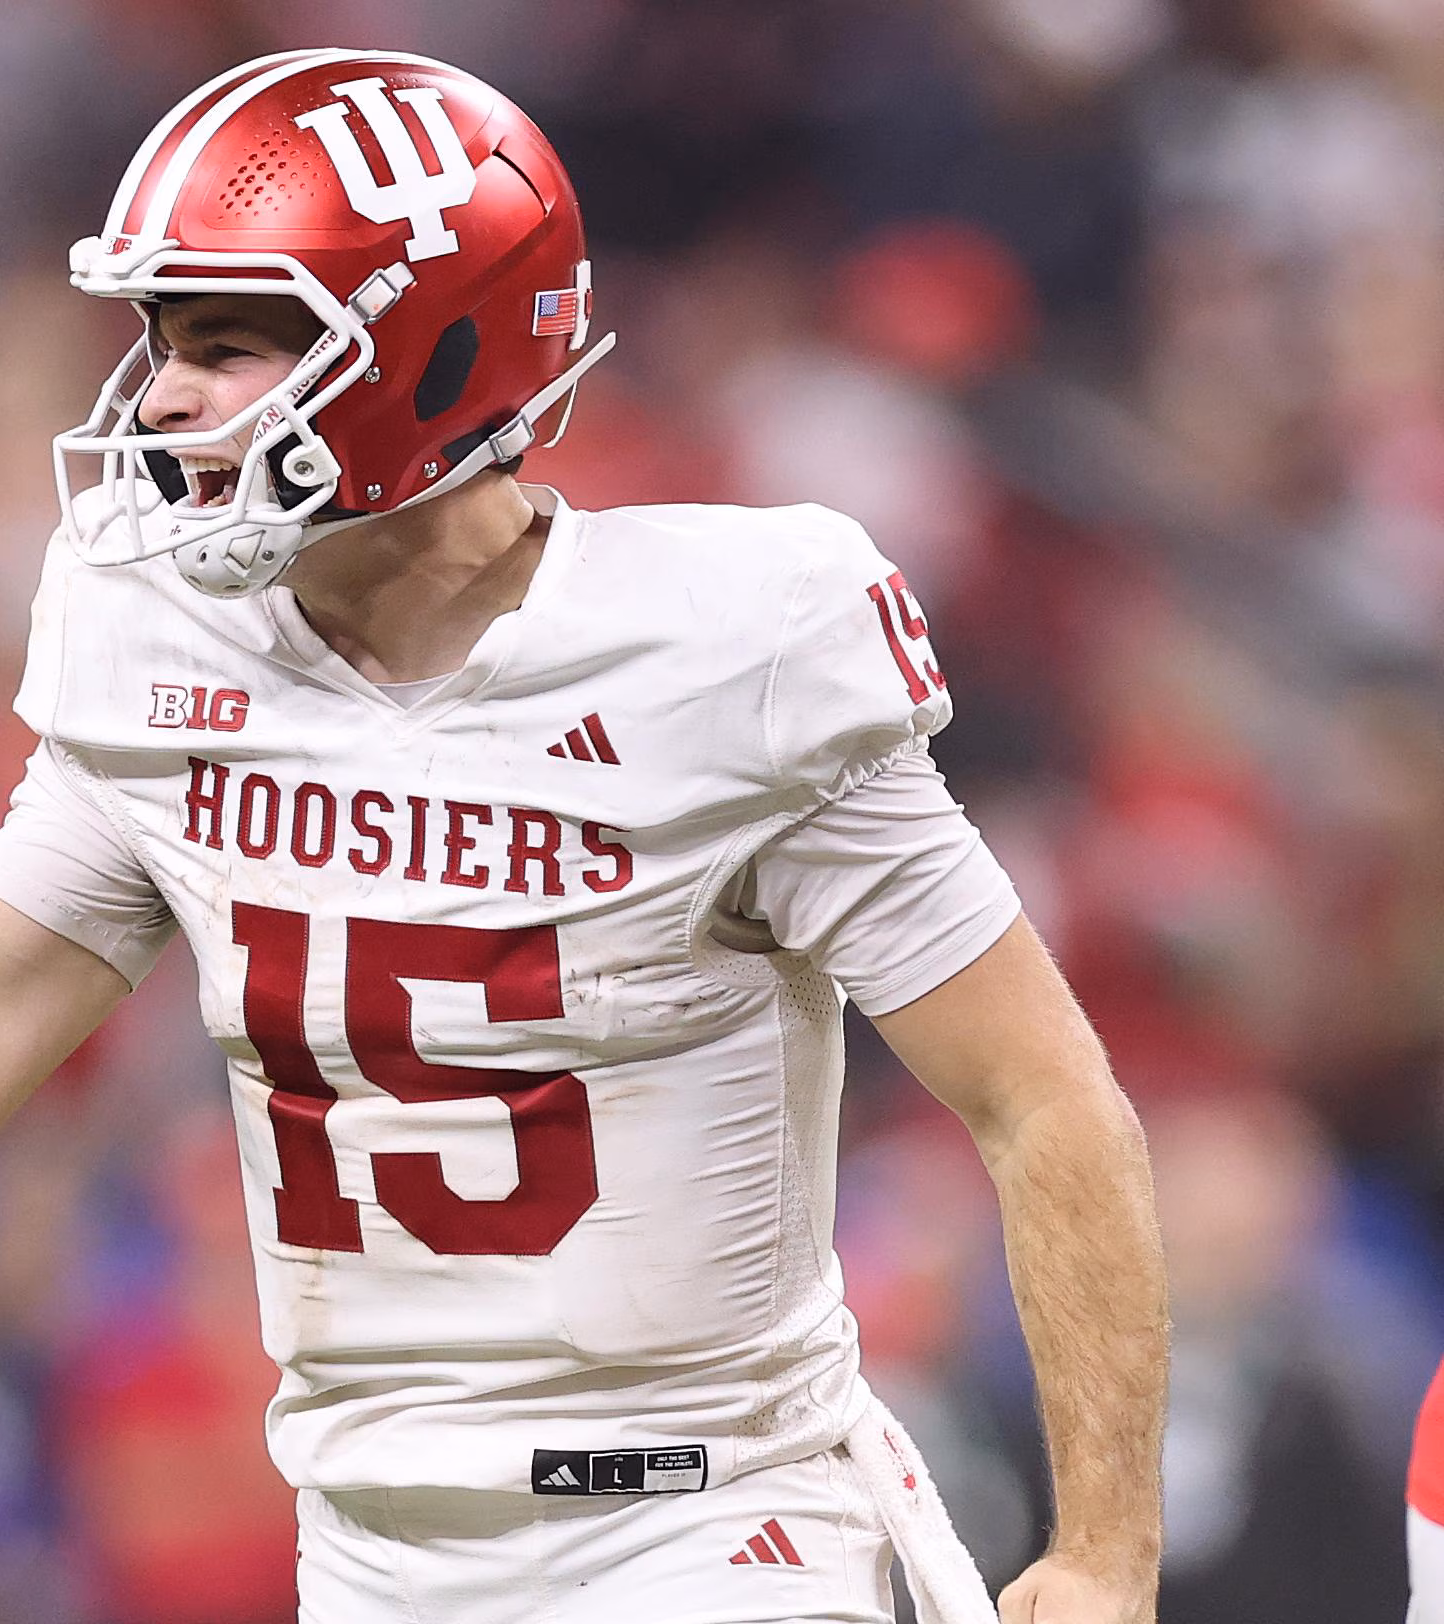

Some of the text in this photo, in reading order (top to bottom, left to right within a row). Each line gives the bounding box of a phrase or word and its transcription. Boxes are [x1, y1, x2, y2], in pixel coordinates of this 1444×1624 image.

[183, 755, 633, 897] HOOSIERS
[231, 900, 600, 1256] 15
[614, 1467, 622, 1484] L
